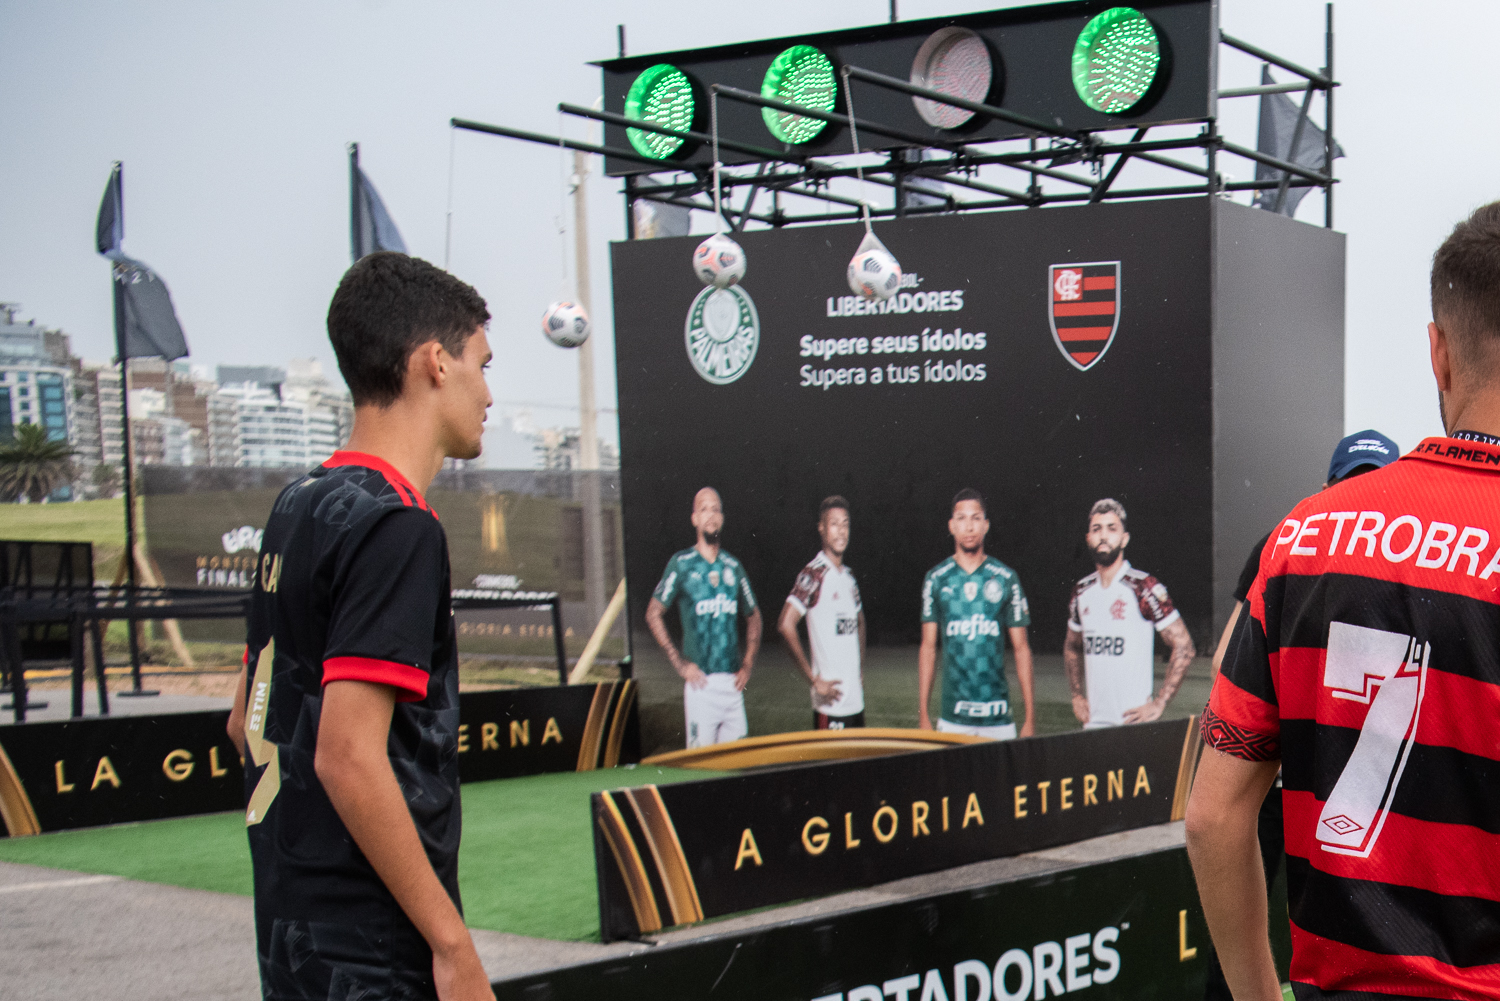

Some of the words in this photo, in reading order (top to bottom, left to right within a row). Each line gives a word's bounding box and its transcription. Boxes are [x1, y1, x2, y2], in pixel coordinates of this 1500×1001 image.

[690, 325, 756, 377] PALMEIRAS
[799, 334, 868, 361] Supere
[870, 334, 919, 354] seus
[921, 327, 987, 352] ídolos
[799, 364, 867, 391] Supera
[869, 366, 884, 385] a
[886, 363, 920, 384] tus
[923, 359, 987, 382] ídolos
[946, 614, 1000, 641] crefisa
[54, 755, 123, 795] LA
[457, 717, 563, 753] ERNA
[1315, 620, 1432, 859] 7
[734, 828, 764, 871] A
[801, 792, 985, 856] GLÓRIA
[1013, 765, 1152, 819] ETERNA
